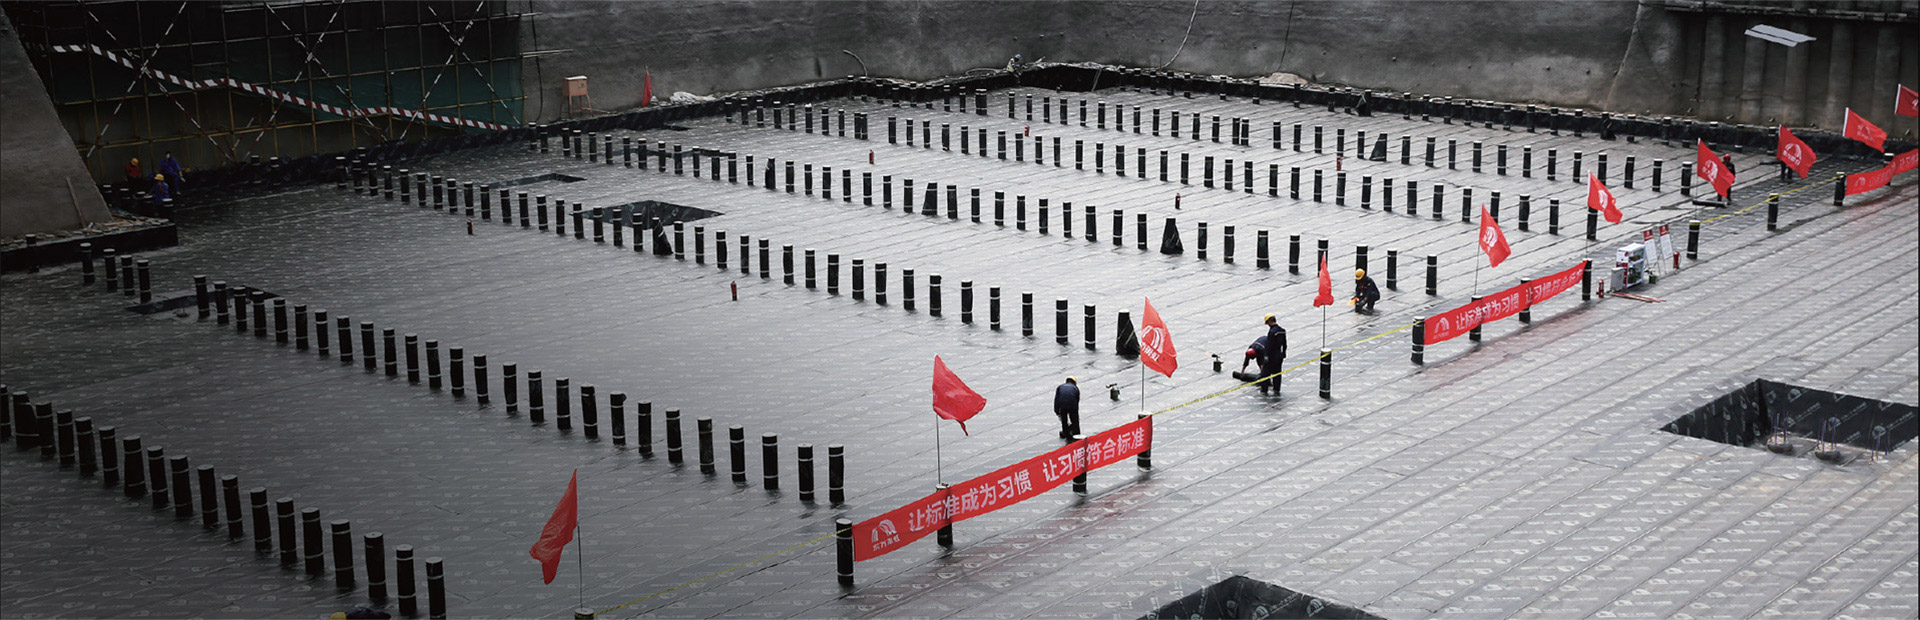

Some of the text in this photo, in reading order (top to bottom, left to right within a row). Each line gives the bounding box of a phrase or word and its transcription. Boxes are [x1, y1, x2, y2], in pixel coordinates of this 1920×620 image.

[1455, 292, 1520, 331] 让标准成为习惯
[1042, 427, 1145, 483] 让习惯符合标准
[908, 469, 1033, 532] 让标准成为习惯
